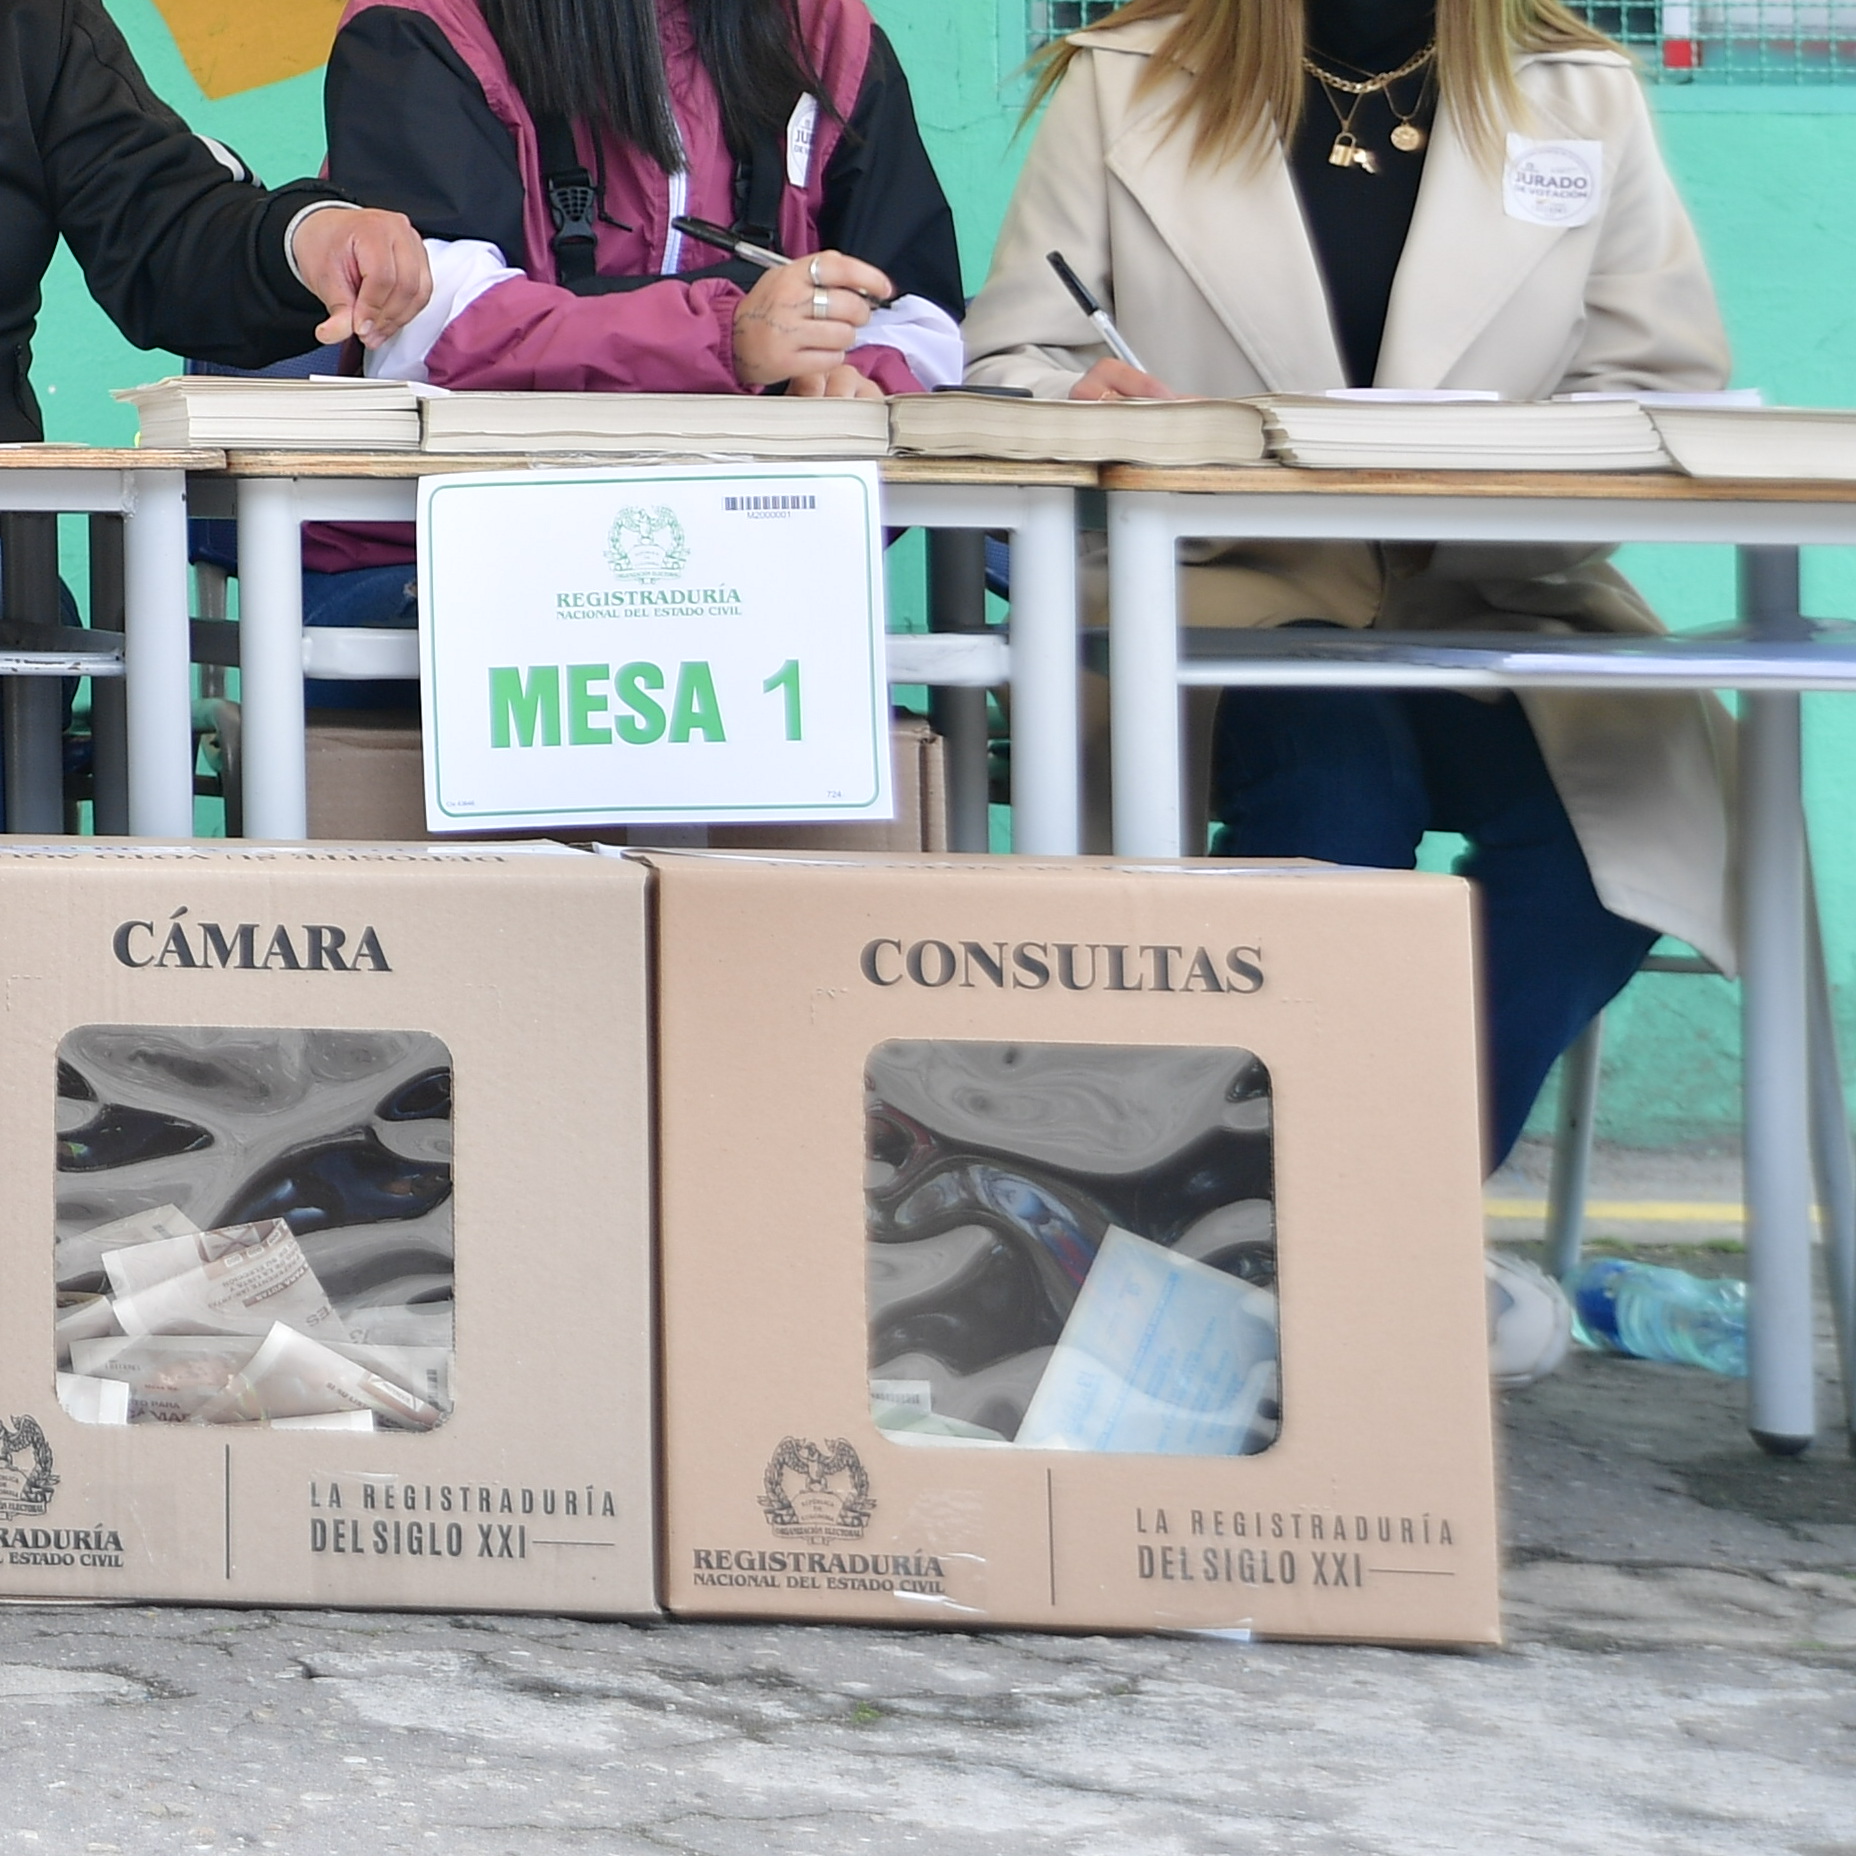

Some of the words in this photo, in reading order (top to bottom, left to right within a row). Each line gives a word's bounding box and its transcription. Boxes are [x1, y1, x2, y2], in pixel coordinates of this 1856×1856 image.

[1515, 171, 1588, 190] JURADO
[556, 583, 742, 609] REGISTRADURÍA
[556, 608, 621, 621] NACIONAL
[624, 607, 650, 619] DEL
[654, 606, 705, 618] ESTADO
[708, 605, 743, 617] CIVIL
[487, 660, 728, 749] MESA
[762, 659, 803, 742] 1
[111, 905, 393, 973] CÁMARA
[858, 937, 1266, 996] CONSULTAS
[8, 1502, 44, 1513] ELECTORAL
[310, 1482, 343, 1510] LA
[363, 1482, 617, 1517] REGISTRADURÍA
[311, 1518, 365, 1554] DEL
[374, 1519, 463, 1558] SIGLO
[477, 1523, 528, 1560] XXI
[774, 1526, 821, 1537] ORGANIZACIÓN
[824, 1528, 861, 1538] ELECTORAL
[1136, 1507, 1168, 1535] LA
[1191, 1511, 1454, 1545] REGISTRADURÍA
[9, 1551, 75, 1566] ESTADO
[80, 1553, 124, 1568] CIVIL
[692, 1548, 945, 1578] REGISTRADURÍA
[1137, 1545, 1194, 1581] DEL
[1202, 1547, 1296, 1585] SIGLO
[1313, 1550, 1364, 1589] XXI
[693, 1573, 780, 1588] NACIONAL
[786, 1576, 821, 1589] DEL
[826, 1577, 894, 1592] ESTADO
[899, 1579, 946, 1594] CIVIL
